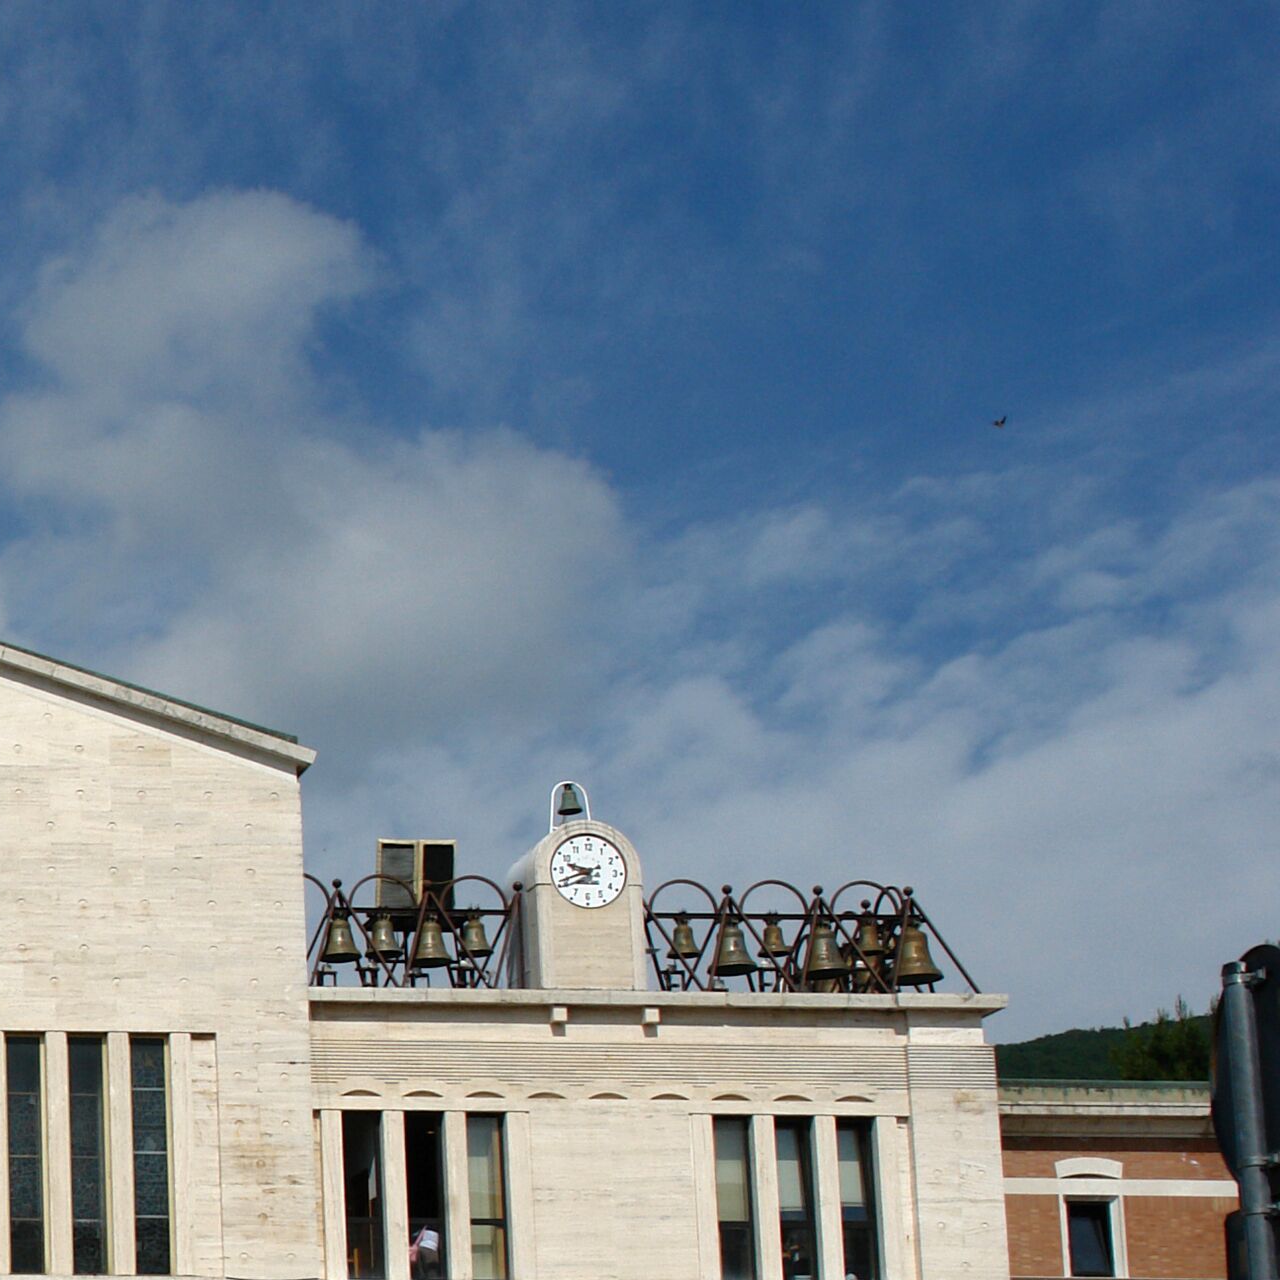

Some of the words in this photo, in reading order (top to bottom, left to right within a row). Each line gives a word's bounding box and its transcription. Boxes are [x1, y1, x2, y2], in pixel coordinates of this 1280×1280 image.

[572, 846, 579, 854] 11
[584, 843, 593, 851] 12
[563, 854, 571, 862] 10
[608, 857, 613, 865] 2
[612, 869, 618, 877] 3
[607, 882, 613, 890] 4
[585, 892, 591, 900] 6
[598, 890, 603, 898] 5
